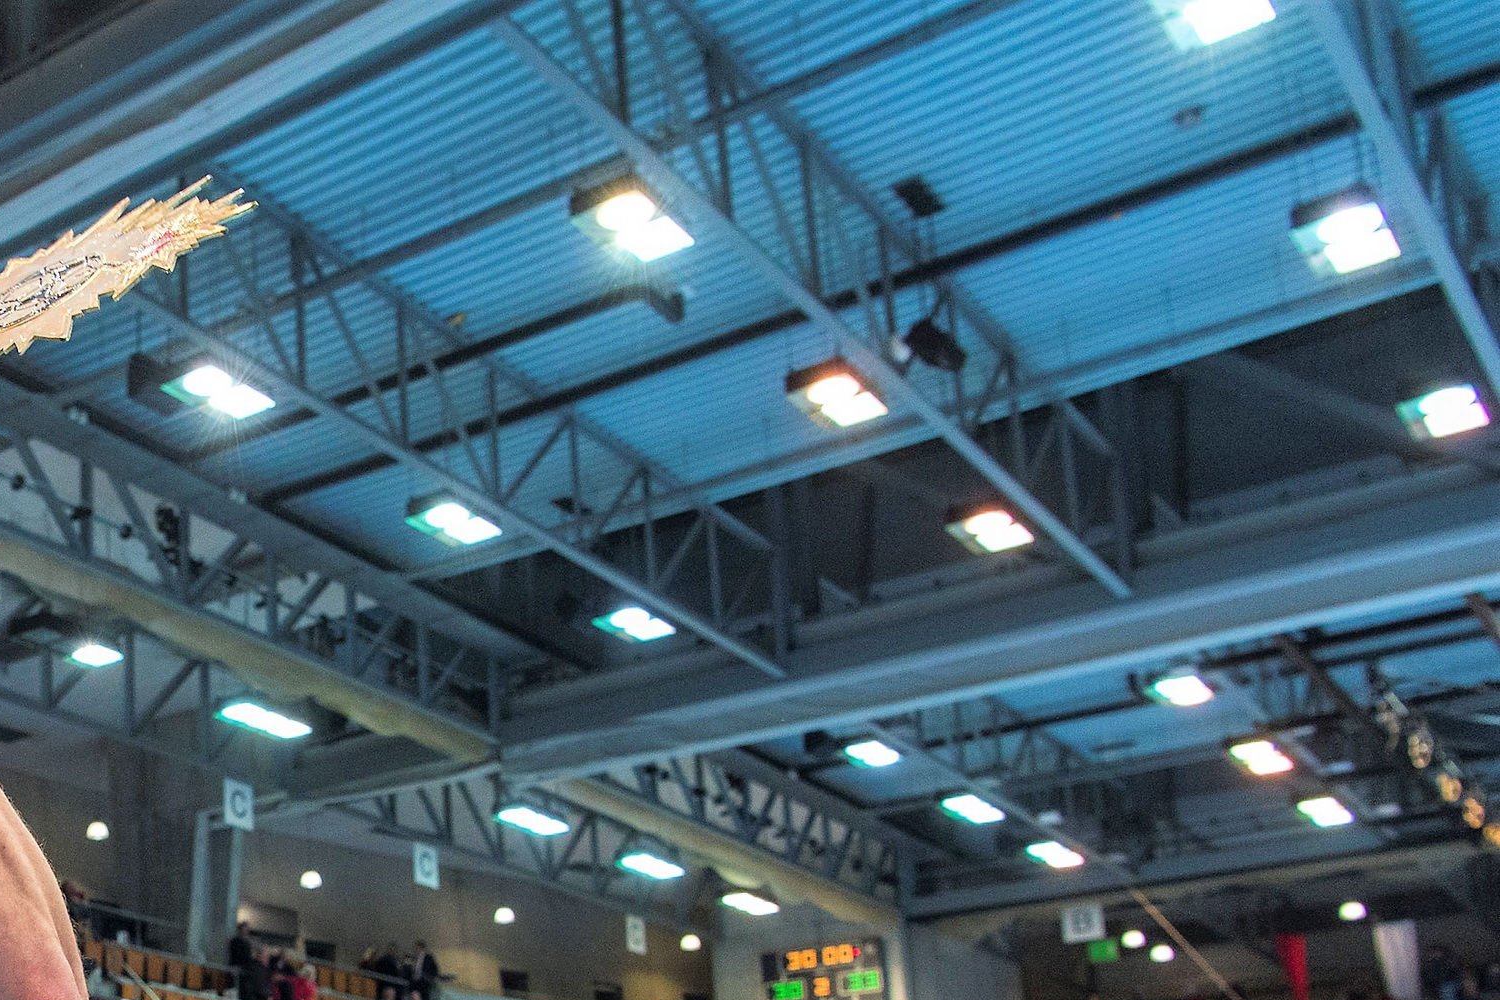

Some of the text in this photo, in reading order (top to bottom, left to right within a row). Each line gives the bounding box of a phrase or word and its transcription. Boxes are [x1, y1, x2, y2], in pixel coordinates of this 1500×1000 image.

[230, 789, 249, 820] C
[785, 943, 855, 972] 30 00
